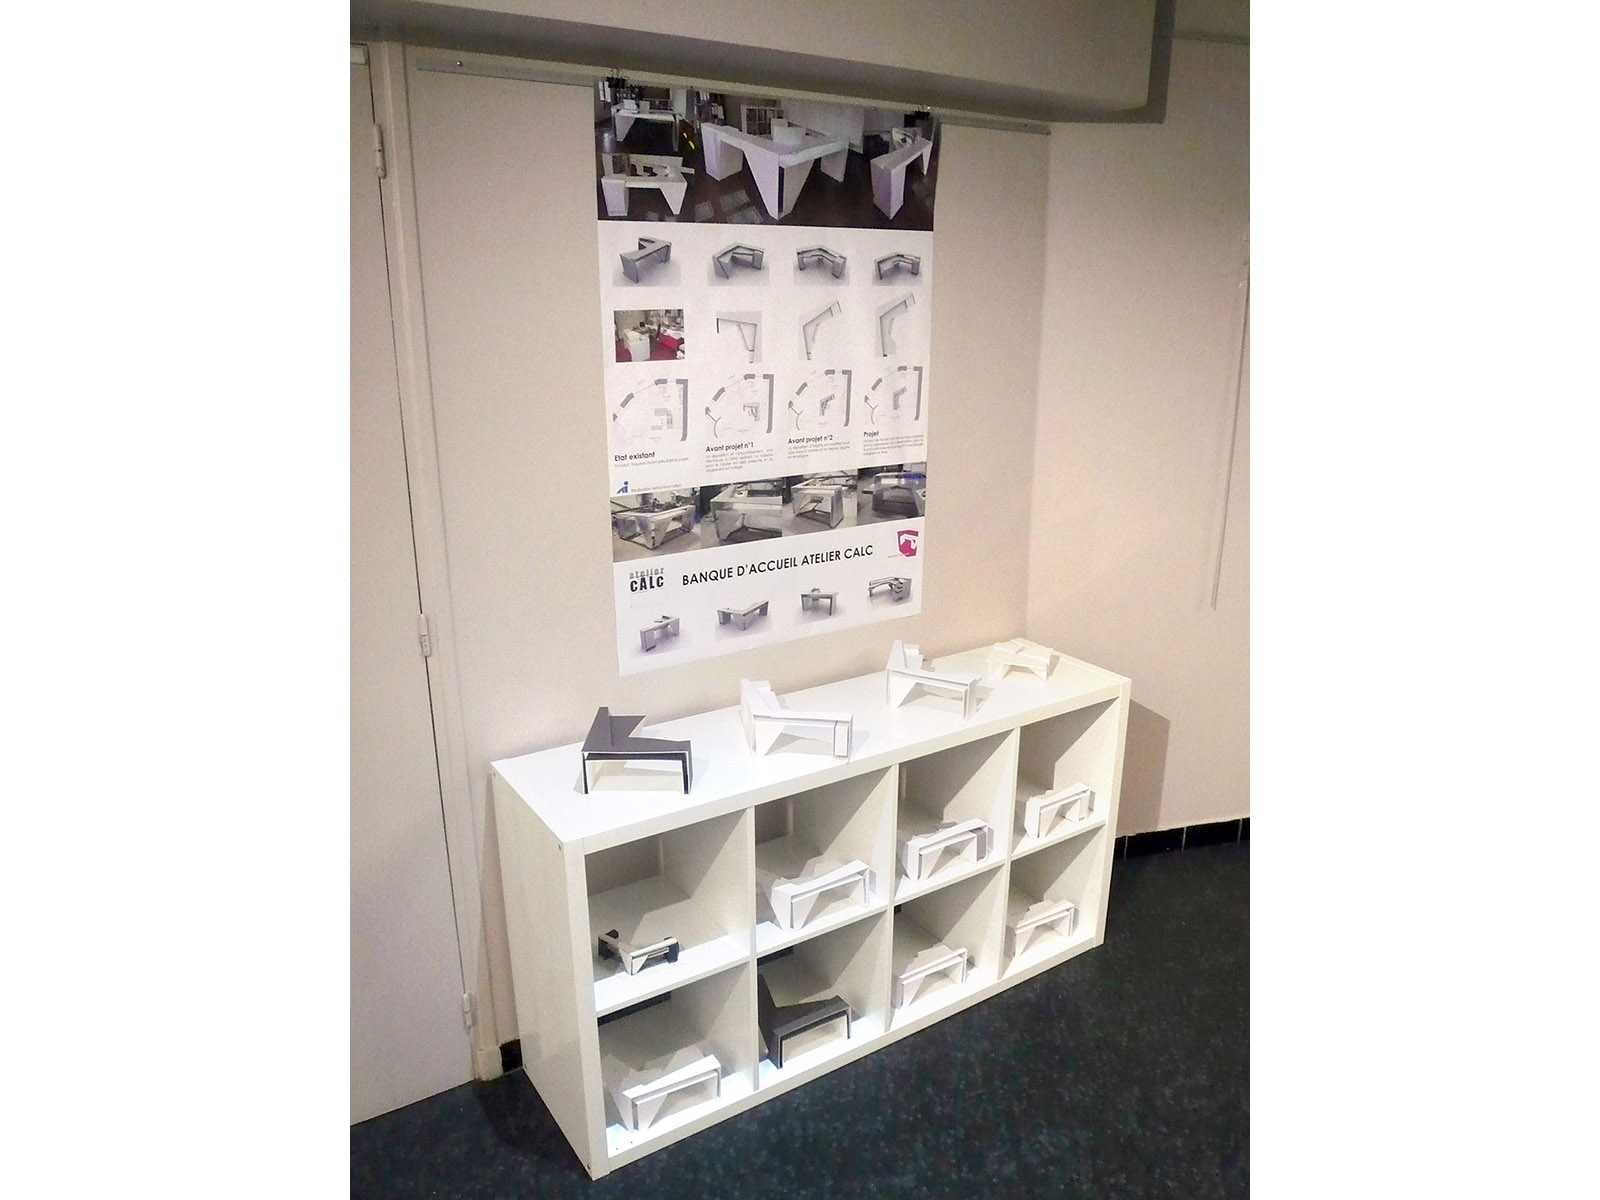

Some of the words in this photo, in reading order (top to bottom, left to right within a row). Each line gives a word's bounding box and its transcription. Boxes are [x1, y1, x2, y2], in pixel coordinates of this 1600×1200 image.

[806, 435, 823, 443] projet
[725, 443, 743, 451] projet
[629, 451, 655, 460] existant
[682, 567, 733, 586] BANQUE
[737, 556, 798, 577] D'ACCUEIL
[801, 550, 841, 566] ATELIER
[844, 545, 873, 559] CALC
[630, 576, 664, 592] CALC
